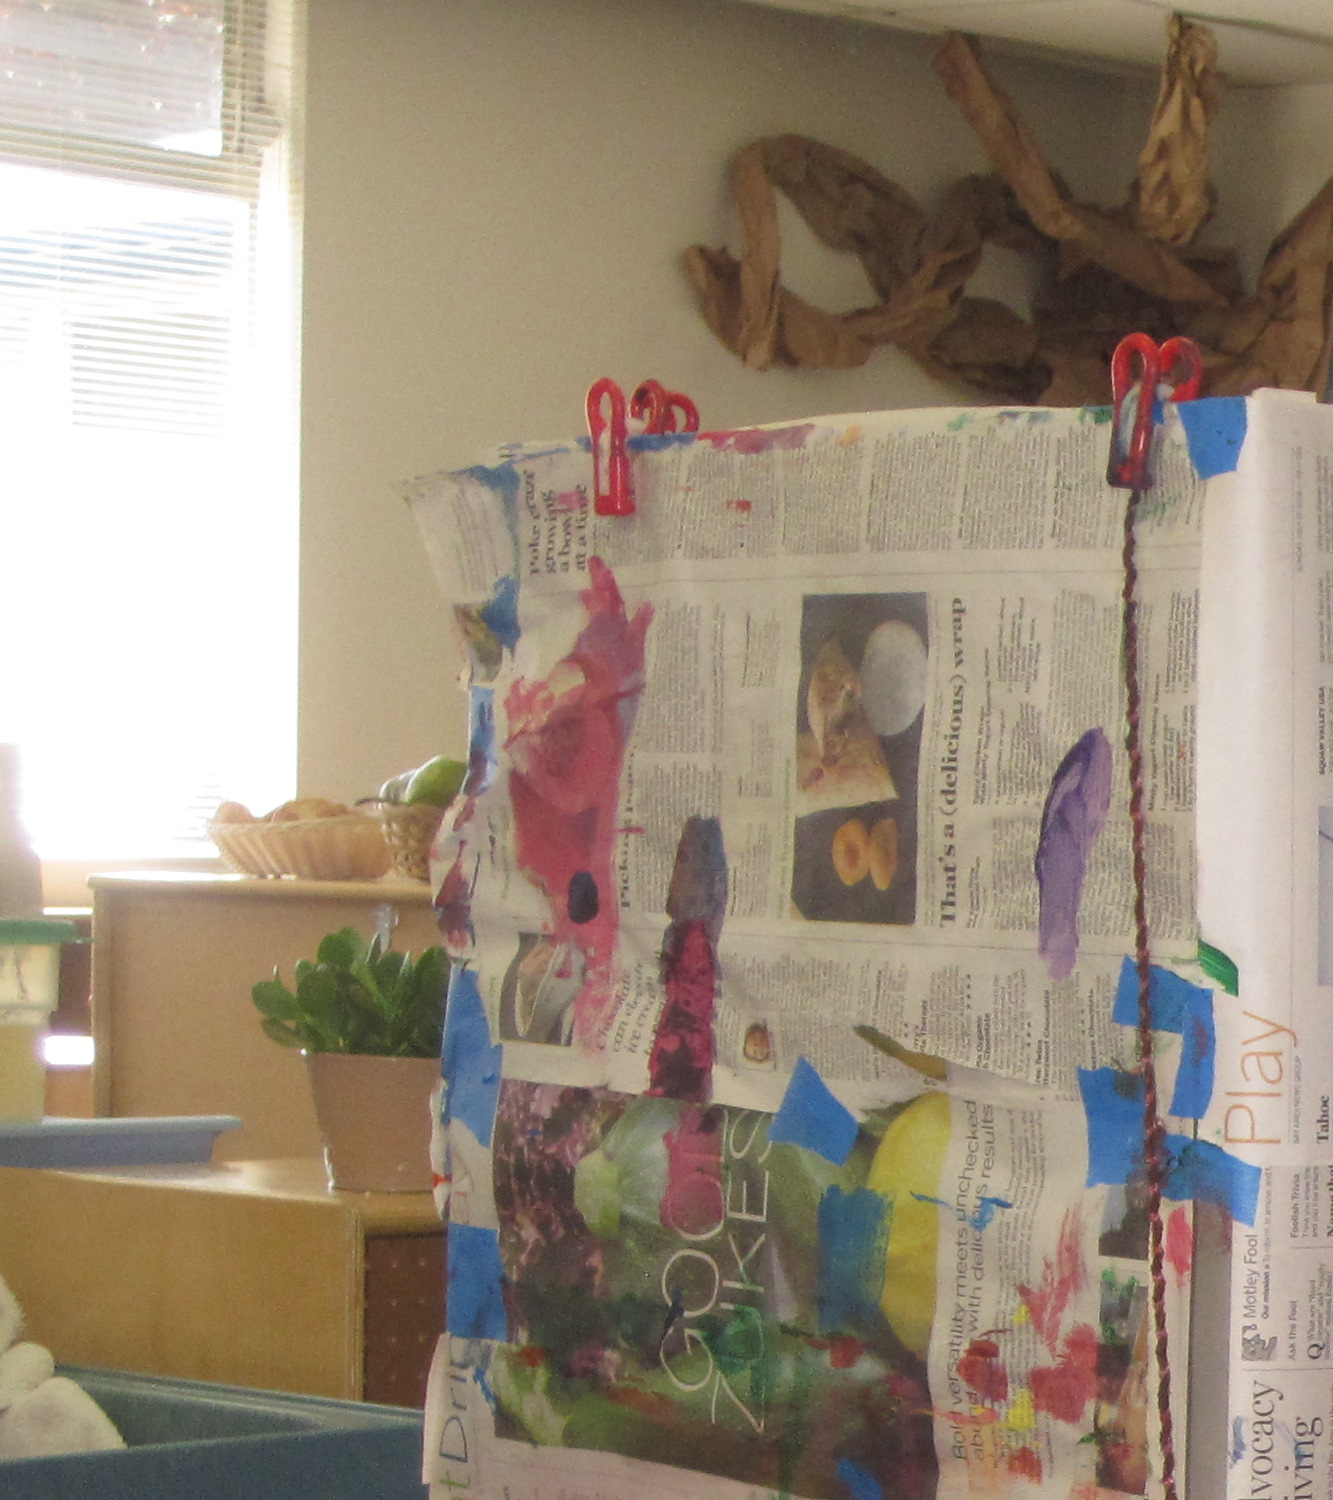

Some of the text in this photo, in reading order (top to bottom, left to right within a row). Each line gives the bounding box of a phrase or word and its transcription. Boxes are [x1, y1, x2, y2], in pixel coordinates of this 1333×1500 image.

[937, 597, 967, 928] That's a (delicious) wrap
[613, 1021, 629, 1053] can
[1223, 1010, 1298, 1145] Play
[980, 1104, 996, 1179] results
[1316, 1095, 1330, 1145] Tahoe
[955, 1100, 979, 1222] unchecked
[969, 1183, 987, 1281] delicous
[1290, 1174, 1300, 1239] Foolish Trivia
[954, 1228, 969, 1298] meets
[1242, 1234, 1262, 1319] Motley Fool
[966, 1287, 982, 1333] with
[1288, 1301, 1298, 1361] Ask the Fool
[947, 1303, 965, 1405] versatility
[1306, 1341, 1325, 1360] Q
